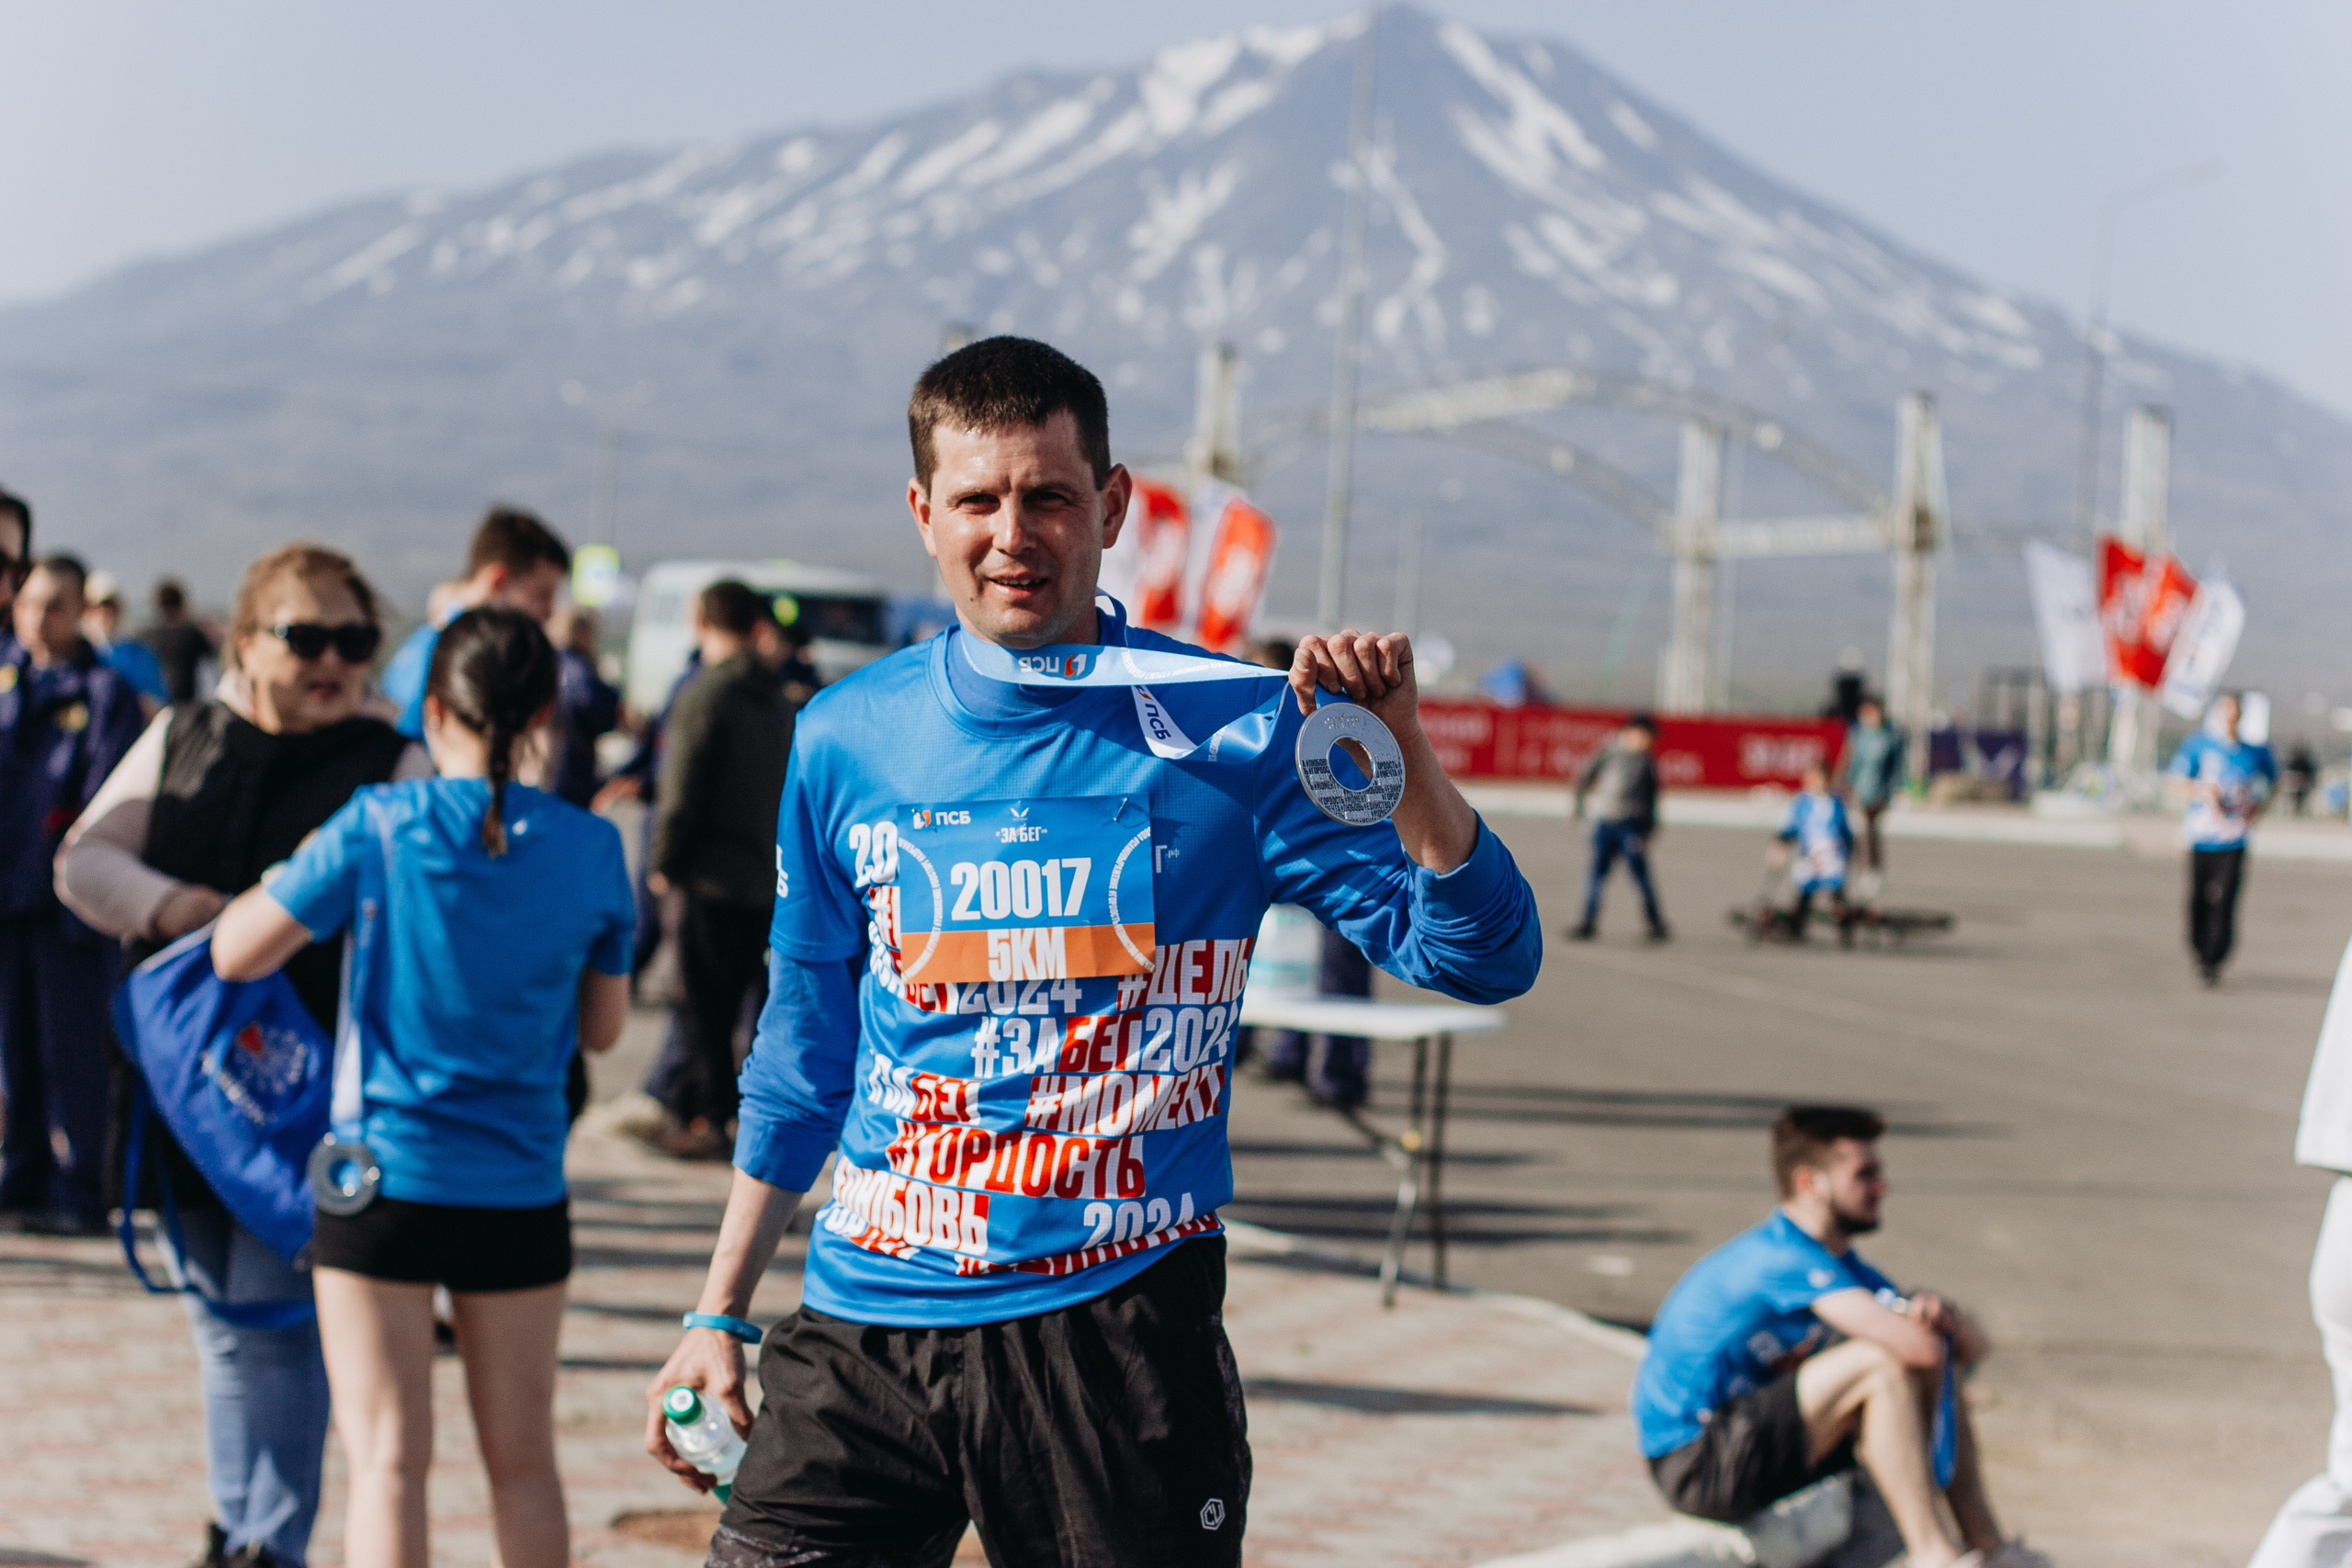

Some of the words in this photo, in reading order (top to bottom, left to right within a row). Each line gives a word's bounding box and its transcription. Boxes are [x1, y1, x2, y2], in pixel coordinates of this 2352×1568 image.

[1018, 656, 1059, 672] ПСБ
[1146, 702, 1171, 740] ПСБ
[934, 810, 971, 825] ПСБ
[950, 856, 1091, 921] 20017
[885, 1118, 1147, 1200] #ГОРДОСТЬ
